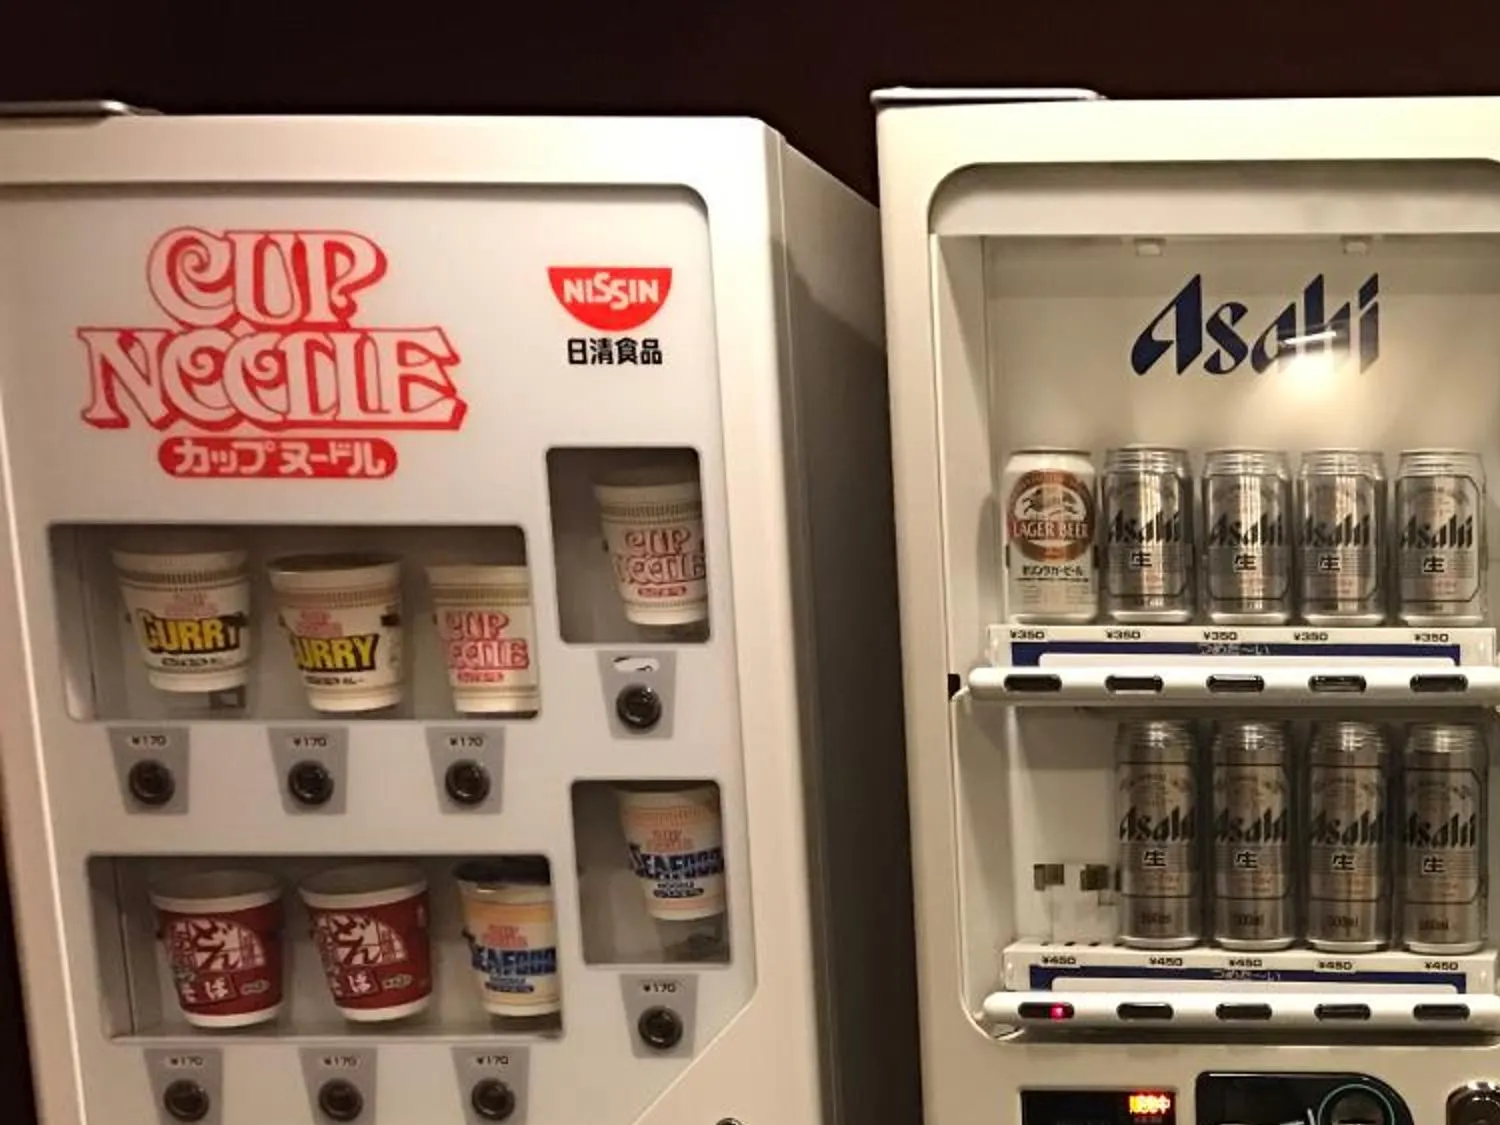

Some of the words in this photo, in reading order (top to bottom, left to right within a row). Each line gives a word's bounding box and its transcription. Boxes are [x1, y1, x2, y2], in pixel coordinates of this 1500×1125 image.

[147, 226, 388, 330] CUP
[562, 271, 660, 305] NISSIN
[1130, 272, 1380, 376] Asahi
[566, 338, 662, 366] 日清食品
[172, 440, 386, 476] カップヌードル
[1010, 520, 1054, 539] LAGER
[1108, 510, 1181, 543] Asahi
[1209, 512, 1284, 546] Asahi
[1300, 512, 1371, 546] Asahi
[1400, 511, 1475, 547] Asahi
[1131, 552, 1152, 568] 生
[1234, 554, 1257, 571] 生
[1318, 554, 1341, 572] 生
[1422, 556, 1446, 573] 生
[1119, 806, 1195, 842] Asahi
[1214, 808, 1288, 844] Asahi
[1310, 809, 1383, 845] Asahi
[1402, 810, 1477, 847] Asahi
[1143, 850, 1166, 867] 生
[1235, 851, 1258, 868] 生
[1332, 852, 1356, 871] 生
[1422, 855, 1446, 873] 生
